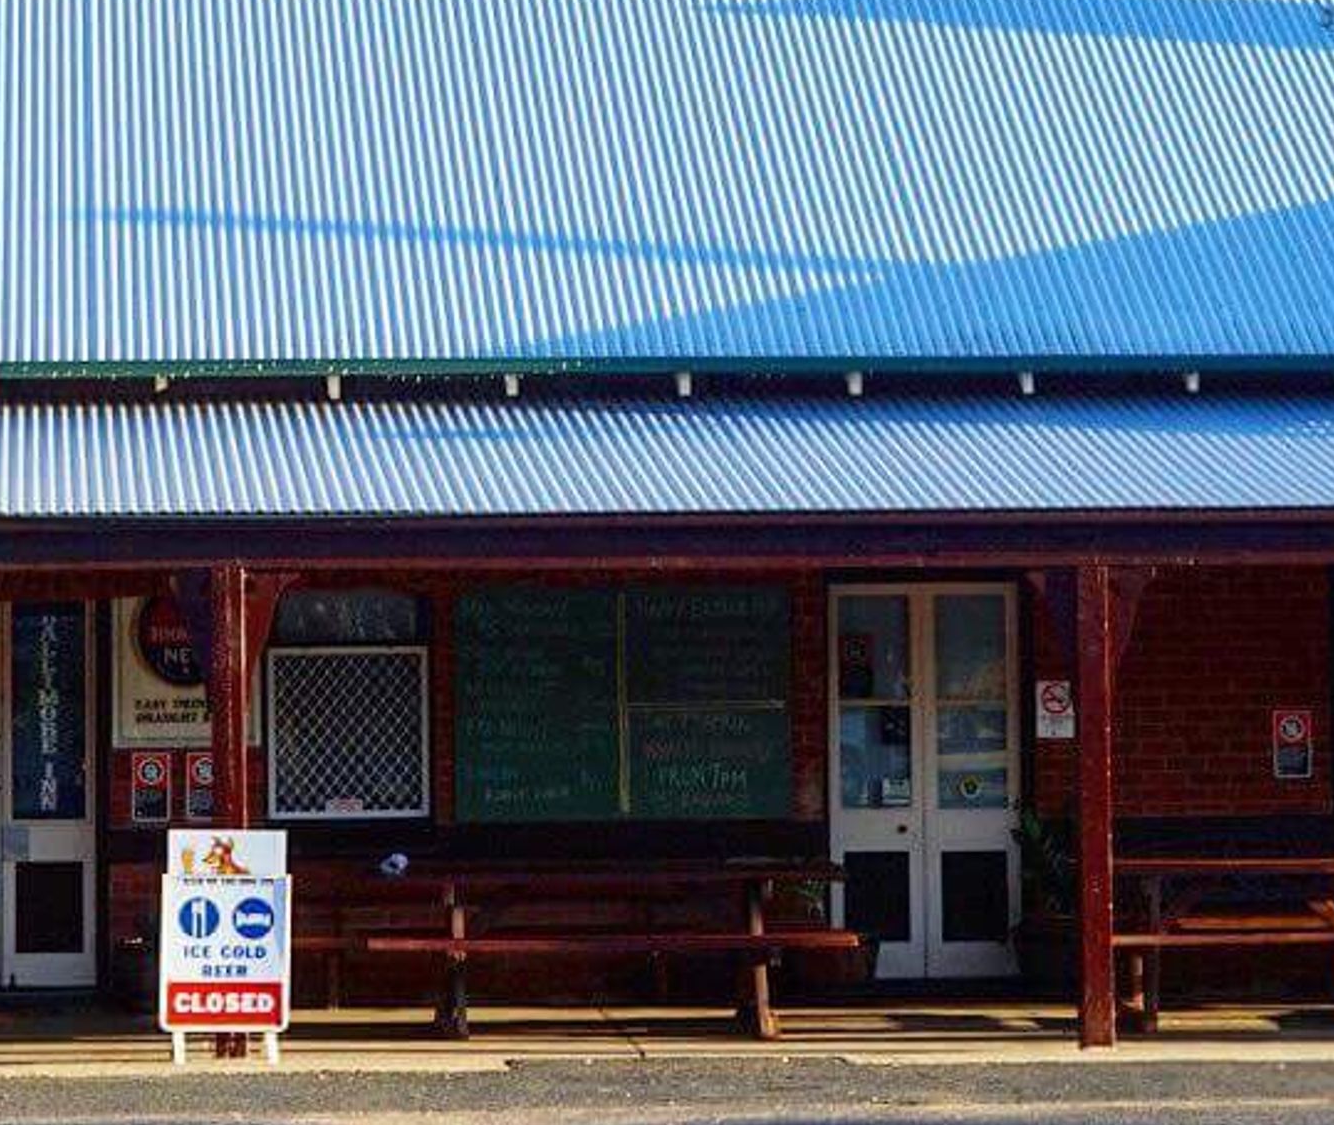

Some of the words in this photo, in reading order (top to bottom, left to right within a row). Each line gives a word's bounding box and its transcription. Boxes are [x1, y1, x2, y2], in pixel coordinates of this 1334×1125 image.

[39, 761, 58, 812] INN
[184, 945, 212, 959] ICE
[220, 945, 267, 959] COLD
[202, 965, 248, 978] BEER
[173, 992, 276, 1015] CLOSED
